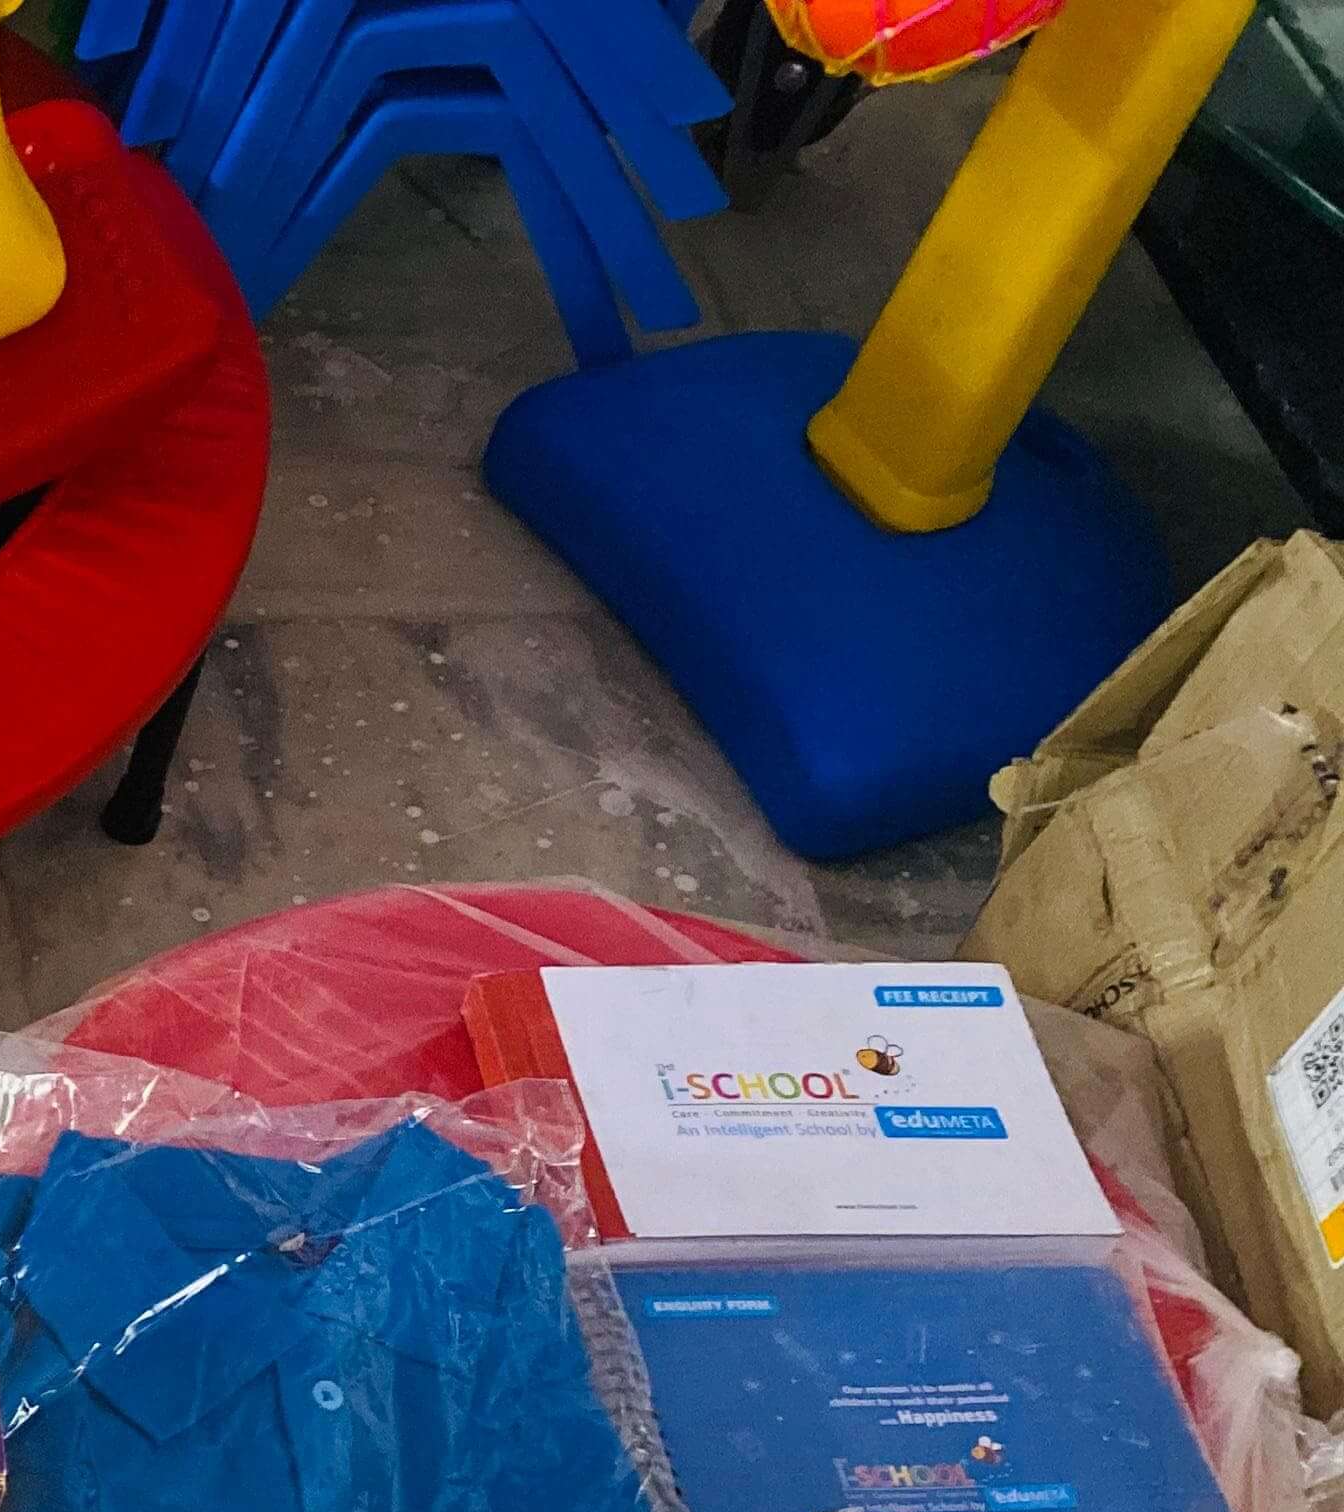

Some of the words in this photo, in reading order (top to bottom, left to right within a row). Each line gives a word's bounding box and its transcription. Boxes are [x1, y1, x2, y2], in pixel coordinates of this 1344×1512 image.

[883, 991, 913, 1003] FEE
[917, 990, 991, 1003] RECEIPT
[657, 1069, 860, 1100] i-SCHOOL
[676, 1124, 701, 1137] An
[704, 1124, 793, 1139] Intelligent
[794, 1123, 852, 1137] School
[856, 1124, 877, 1138] by
[891, 1111, 996, 1129] eduMETA
